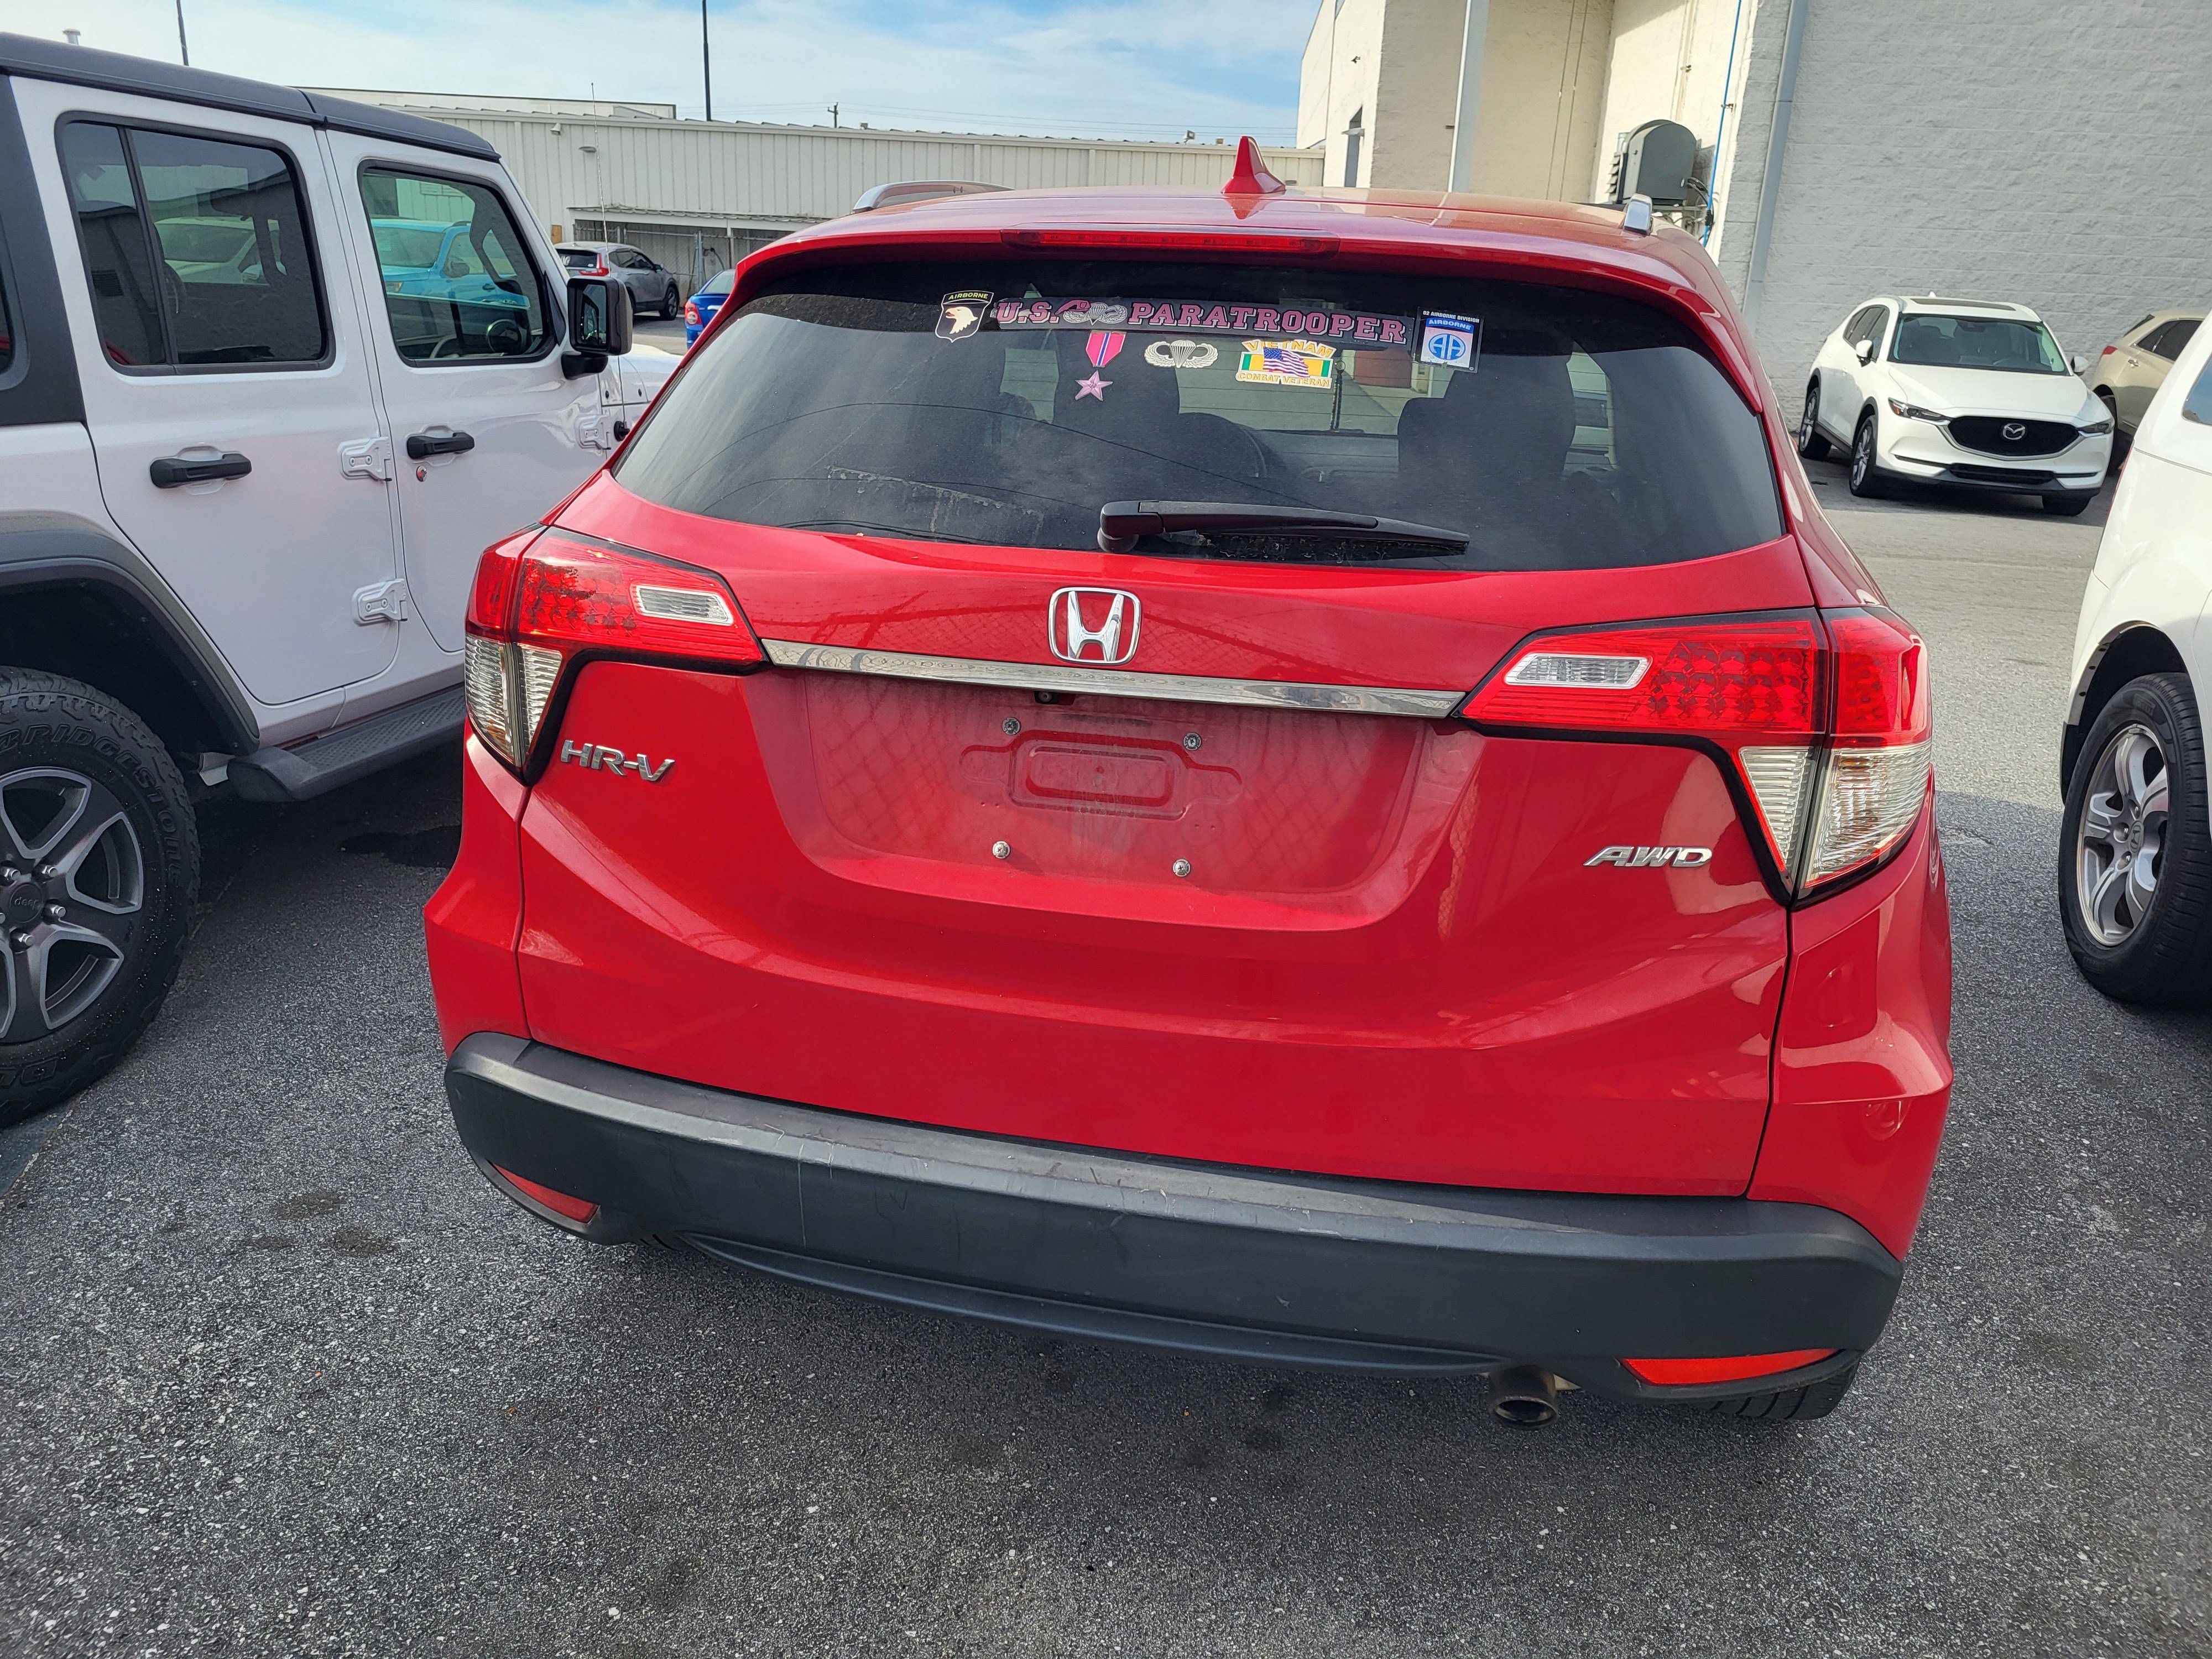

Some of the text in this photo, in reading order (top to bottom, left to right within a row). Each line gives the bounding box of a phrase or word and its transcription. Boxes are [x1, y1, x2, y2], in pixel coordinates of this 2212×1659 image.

[948, 292, 988, 300] AIRBORNE
[996, 301, 1406, 345] U.S. PARATROOPER
[1430, 311, 1457, 320] AIRBORNE
[1428, 319, 1472, 330] AIRBORNE
[1245, 341, 1334, 358] VIETNAM
[1238, 372, 1330, 387] COMBAT VETERAN
[560, 739, 675, 781] HR-V
[1583, 845, 1713, 867] AWD
